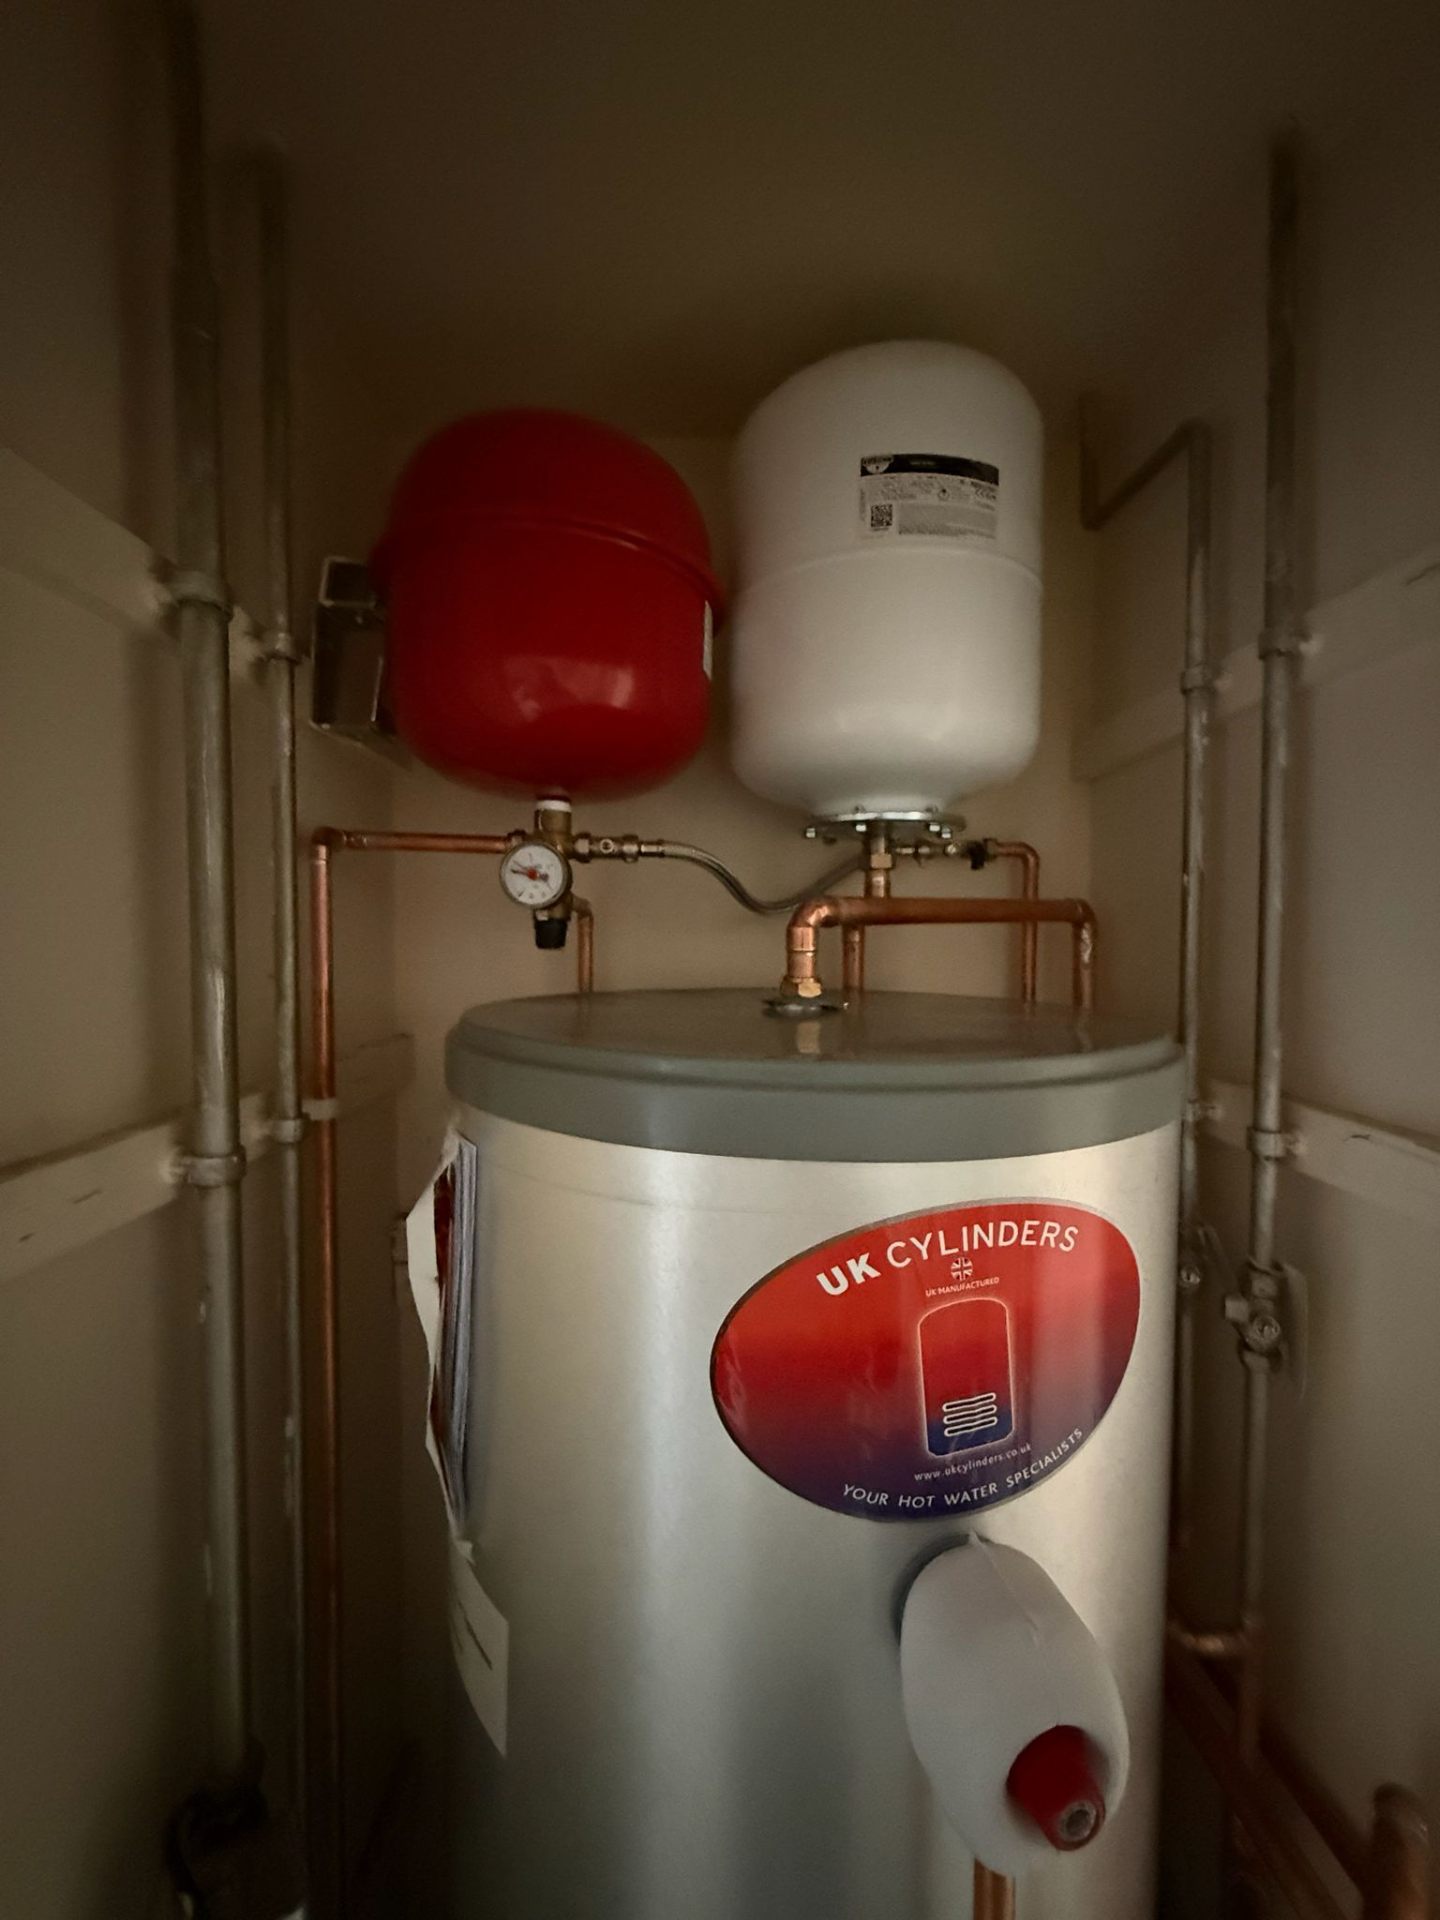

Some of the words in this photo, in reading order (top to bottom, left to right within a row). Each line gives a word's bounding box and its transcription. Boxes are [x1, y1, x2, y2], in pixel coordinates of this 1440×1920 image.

[816, 1253, 881, 1296] UK
[887, 1220, 1078, 1268] CYLINDERS
[925, 1288, 937, 1298] UK
[938, 1276, 1000, 1296] MANUFACTURED
[842, 1484, 889, 1506] YOUR
[899, 1495, 936, 1509] HOT
[944, 1482, 998, 1507] WATER
[1006, 1428, 1083, 1487] SPECIALISTS
